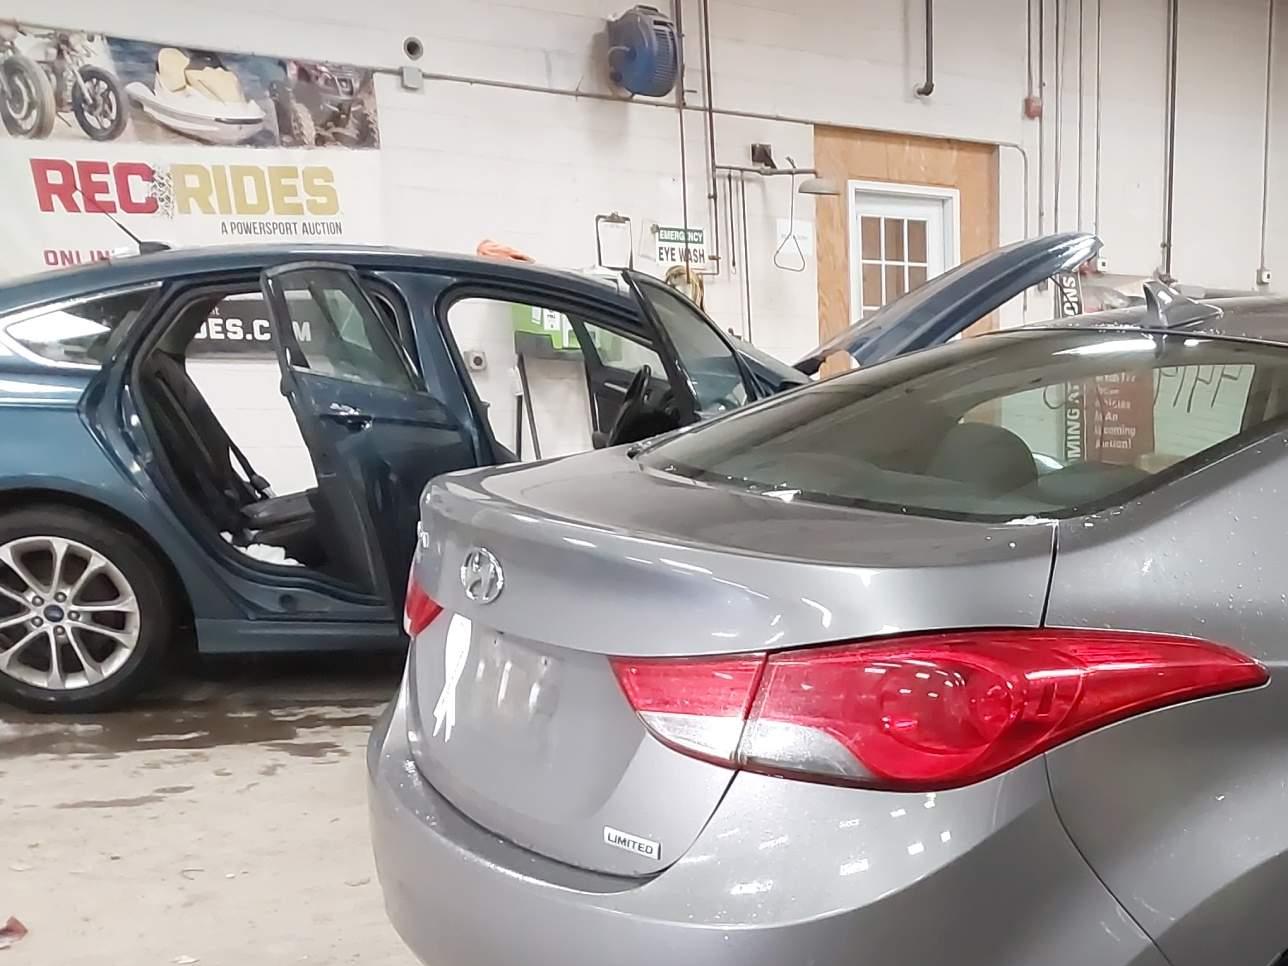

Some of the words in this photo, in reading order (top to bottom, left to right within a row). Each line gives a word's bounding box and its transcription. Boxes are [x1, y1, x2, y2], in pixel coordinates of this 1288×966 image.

[30, 158, 158, 214] REC
[171, 163, 340, 215] RIDES
[221, 221, 228, 234] A
[230, 221, 298, 235] POWERSPORT
[302, 222, 343, 235] AUCTION
[659, 229, 703, 242] EMERGNCY
[44, 250, 114, 266] ONLIN
[658, 246, 676, 262] EYE
[679, 247, 705, 263] WASH
[607, 832, 653, 854] LIMITED
